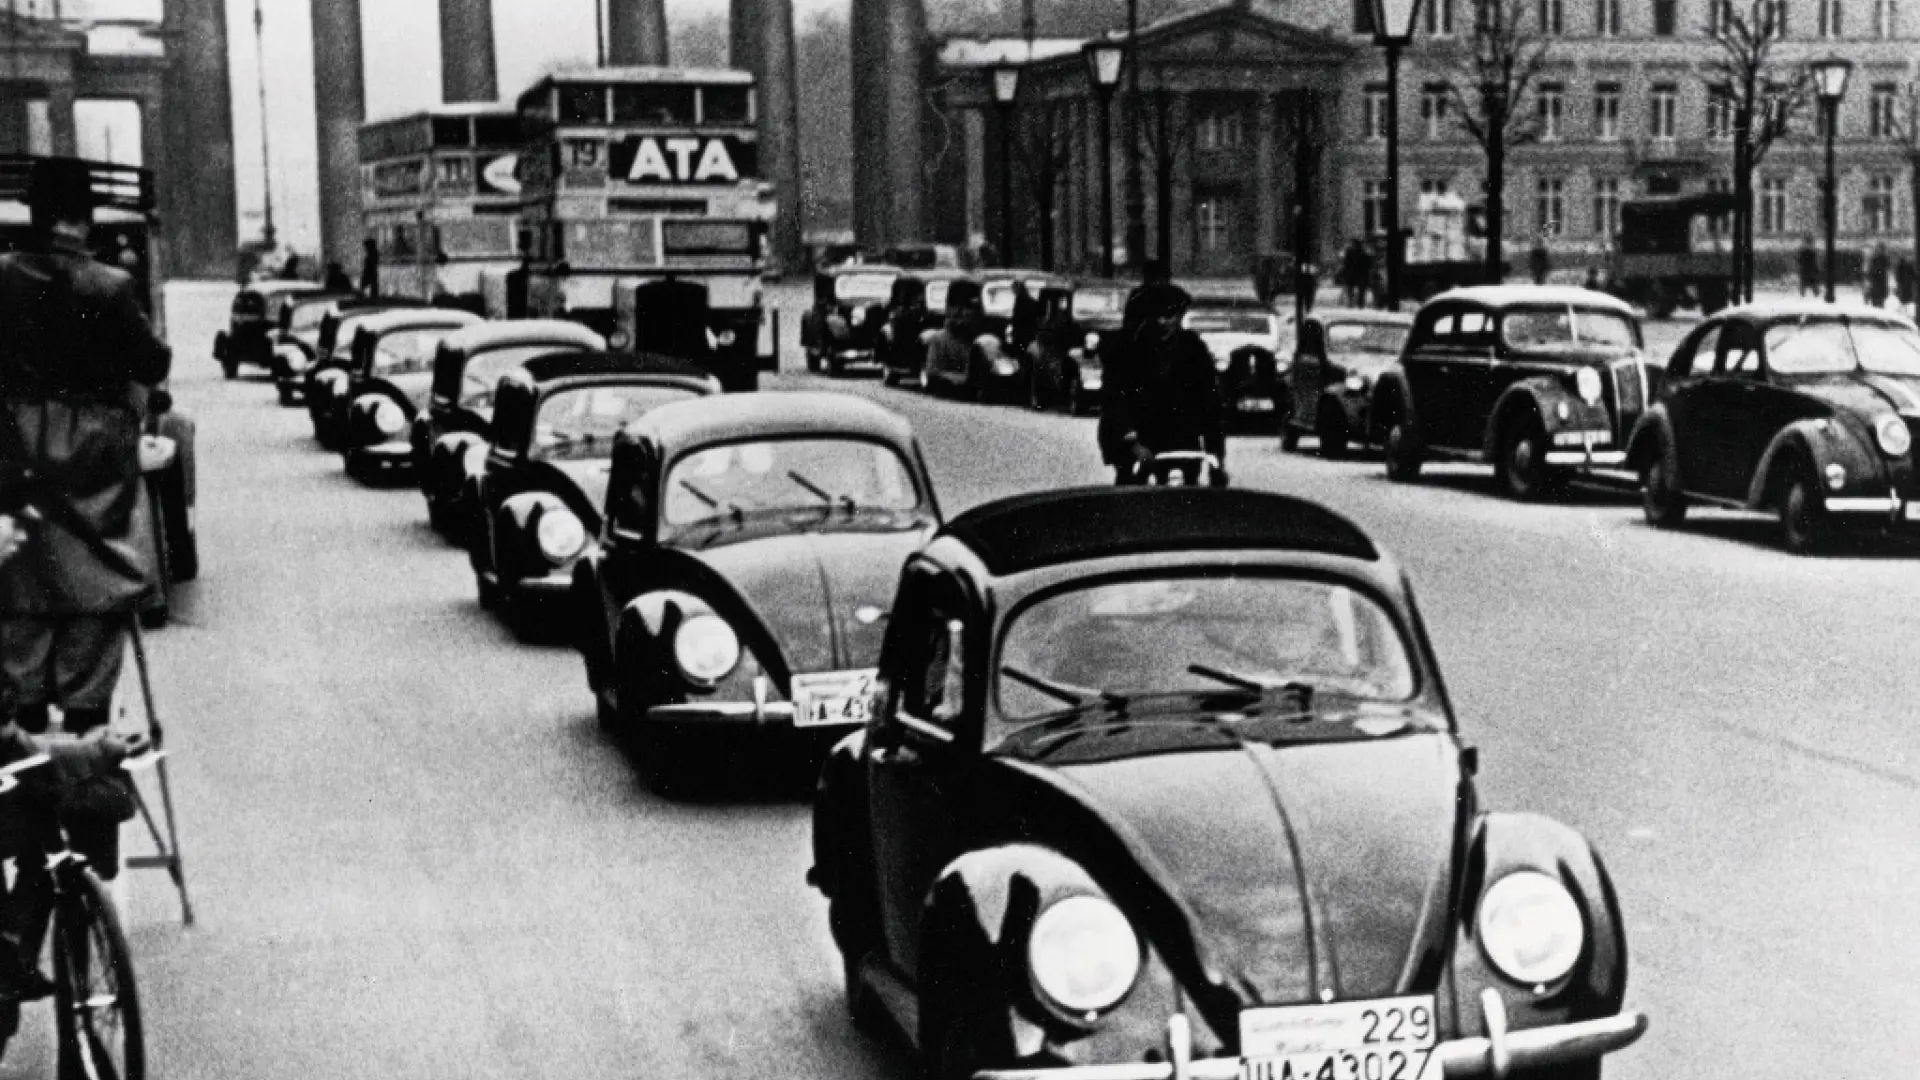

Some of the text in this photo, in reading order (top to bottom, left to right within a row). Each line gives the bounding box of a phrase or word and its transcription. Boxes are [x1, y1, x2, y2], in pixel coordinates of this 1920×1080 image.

[628, 137, 738, 181] ATA
[858, 674, 871, 697] 2
[1361, 1005, 1430, 1044] 229
